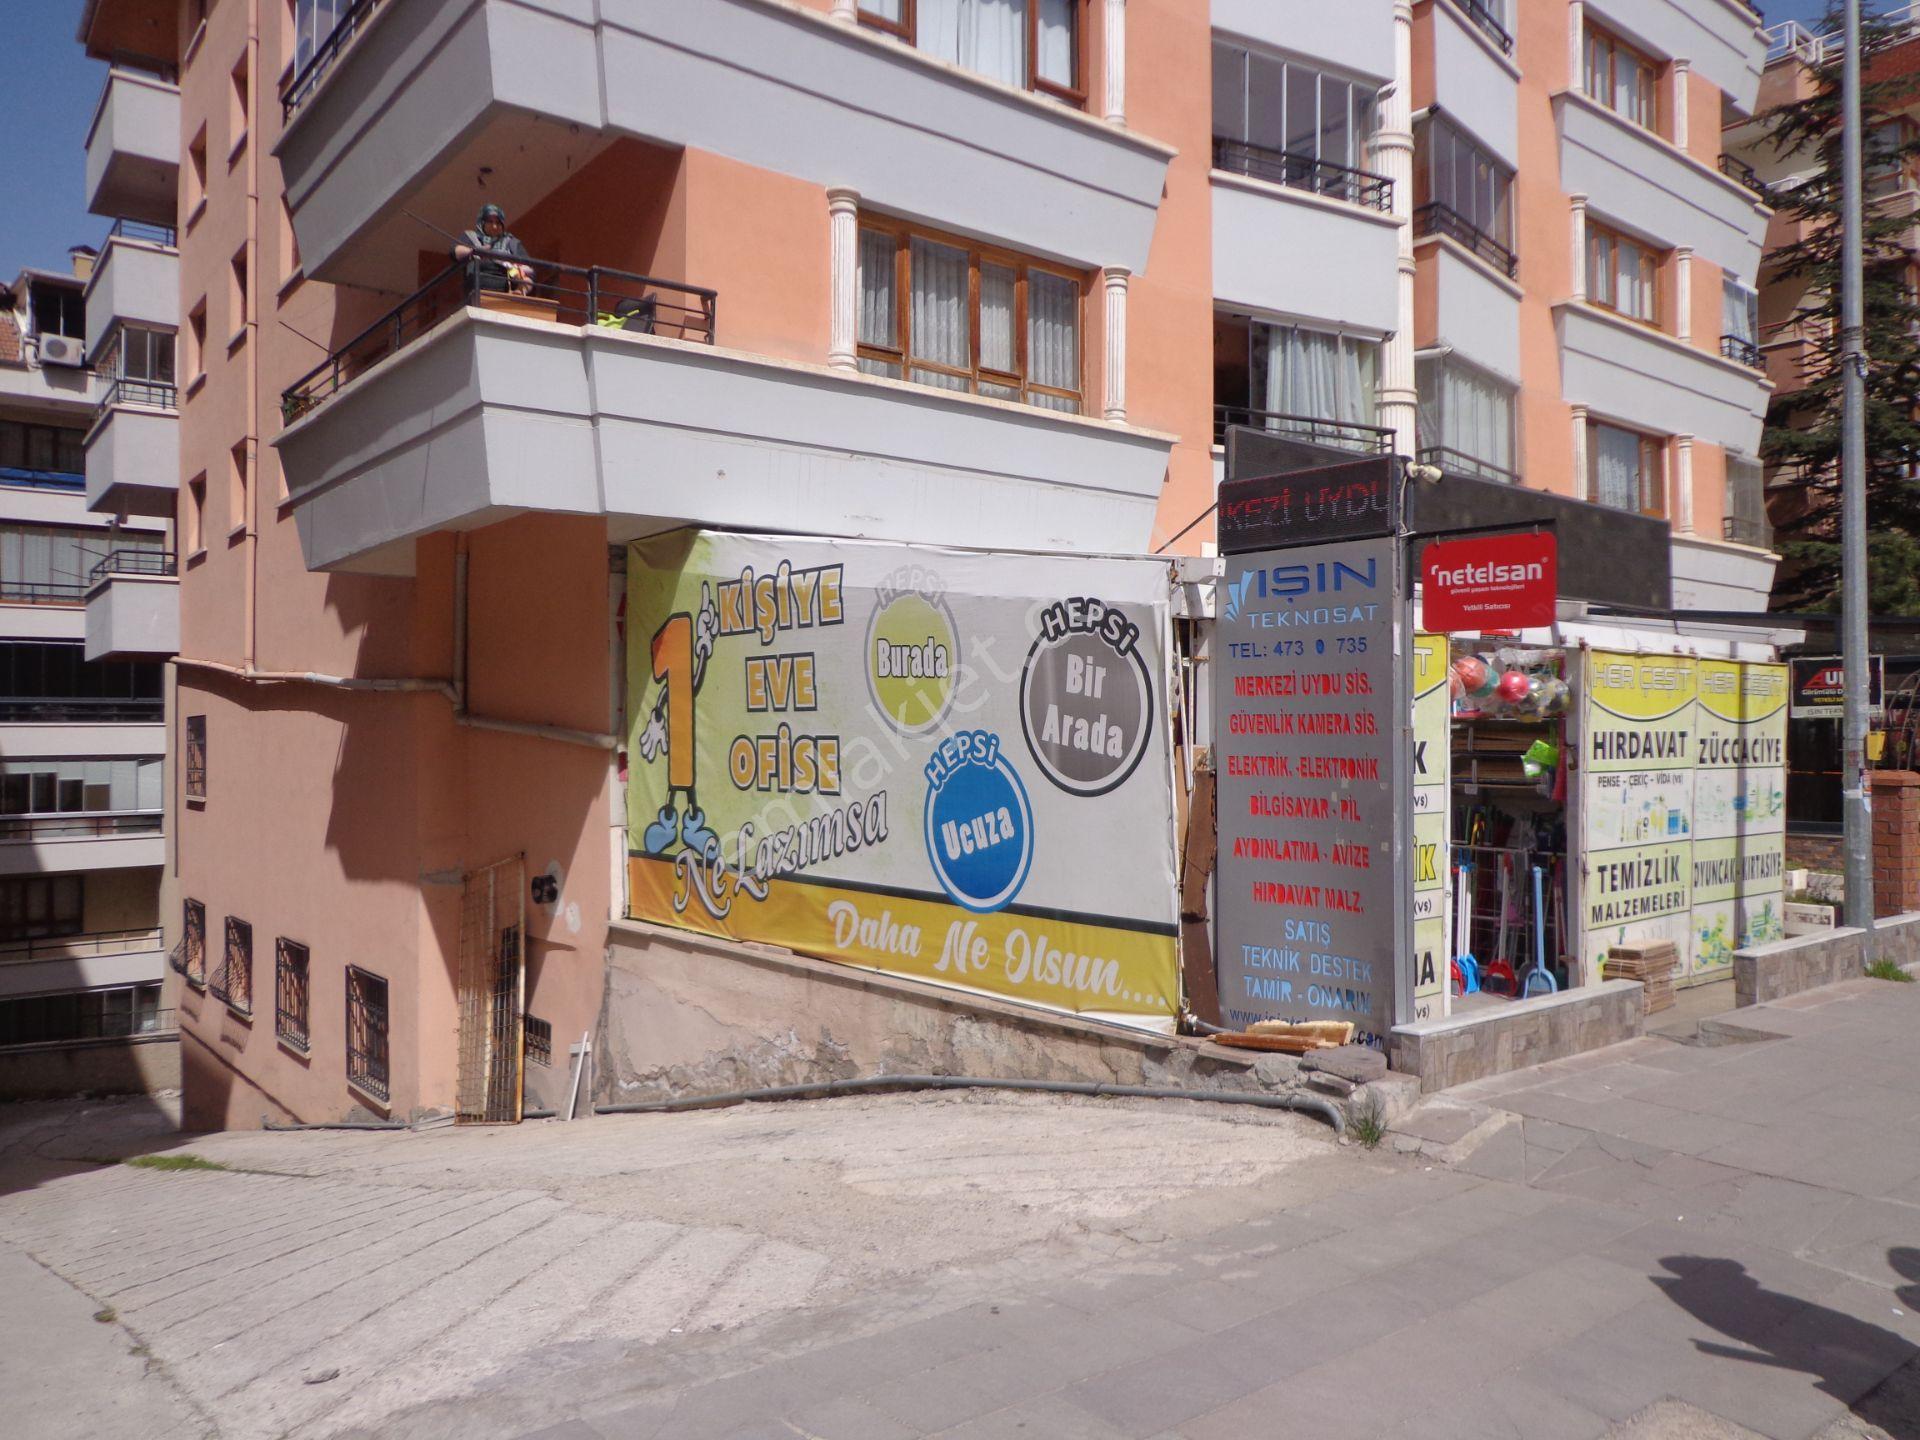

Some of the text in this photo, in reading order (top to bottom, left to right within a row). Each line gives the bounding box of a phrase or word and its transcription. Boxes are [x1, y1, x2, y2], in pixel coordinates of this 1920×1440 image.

[1257, 558, 1377, 603] IŞIN
[716, 558, 845, 646] KİŞİYE
[1247, 605, 1379, 629] TEKNOSAT
[876, 636, 949, 679] Burada
[1228, 642, 1267, 659] TEL:
[1273, 640, 1305, 656] 473
[1336, 637, 1368, 653] 735
[745, 651, 818, 712] EVE
[1066, 653, 1107, 700] Bir
[1233, 667, 1374, 697] MERKEZİ UYDU SİS.
[1593, 662, 1635, 690] HER
[1041, 704, 1123, 759] Arada
[1229, 707, 1379, 736] GÜVENLİK KAMERA SİS.
[729, 721, 842, 797] OFİSE
[1592, 730, 1689, 761] HIRDAVAT
[1698, 730, 1782, 765] ZÜCCACİYE
[1597, 775, 1621, 788] PENSE
[1656, 771, 1671, 785] VİDA
[1249, 790, 1361, 822] BİLGİSAYAR PİL
[941, 806, 1015, 861] Ucuza
[1233, 837, 1370, 868] AYDINLATMA AVİZE
[672, 789, 889, 921] Ne Lazımsa
[1597, 847, 1681, 894] TEMİZLİK
[1694, 846, 1782, 888] OYUNCAK KIRTASİYE
[1252, 881, 1364, 914] HIRDAVAT MALZ.
[1591, 885, 1685, 924] MALZEMELERİ
[827, 899, 921, 958] Daha
[934, 920, 991, 974] Ne
[1284, 918, 1331, 949] SATIŞ
[1241, 943, 1373, 984] TEKNİK DESTEK
[1243, 975, 1293, 1003] TAMİR
